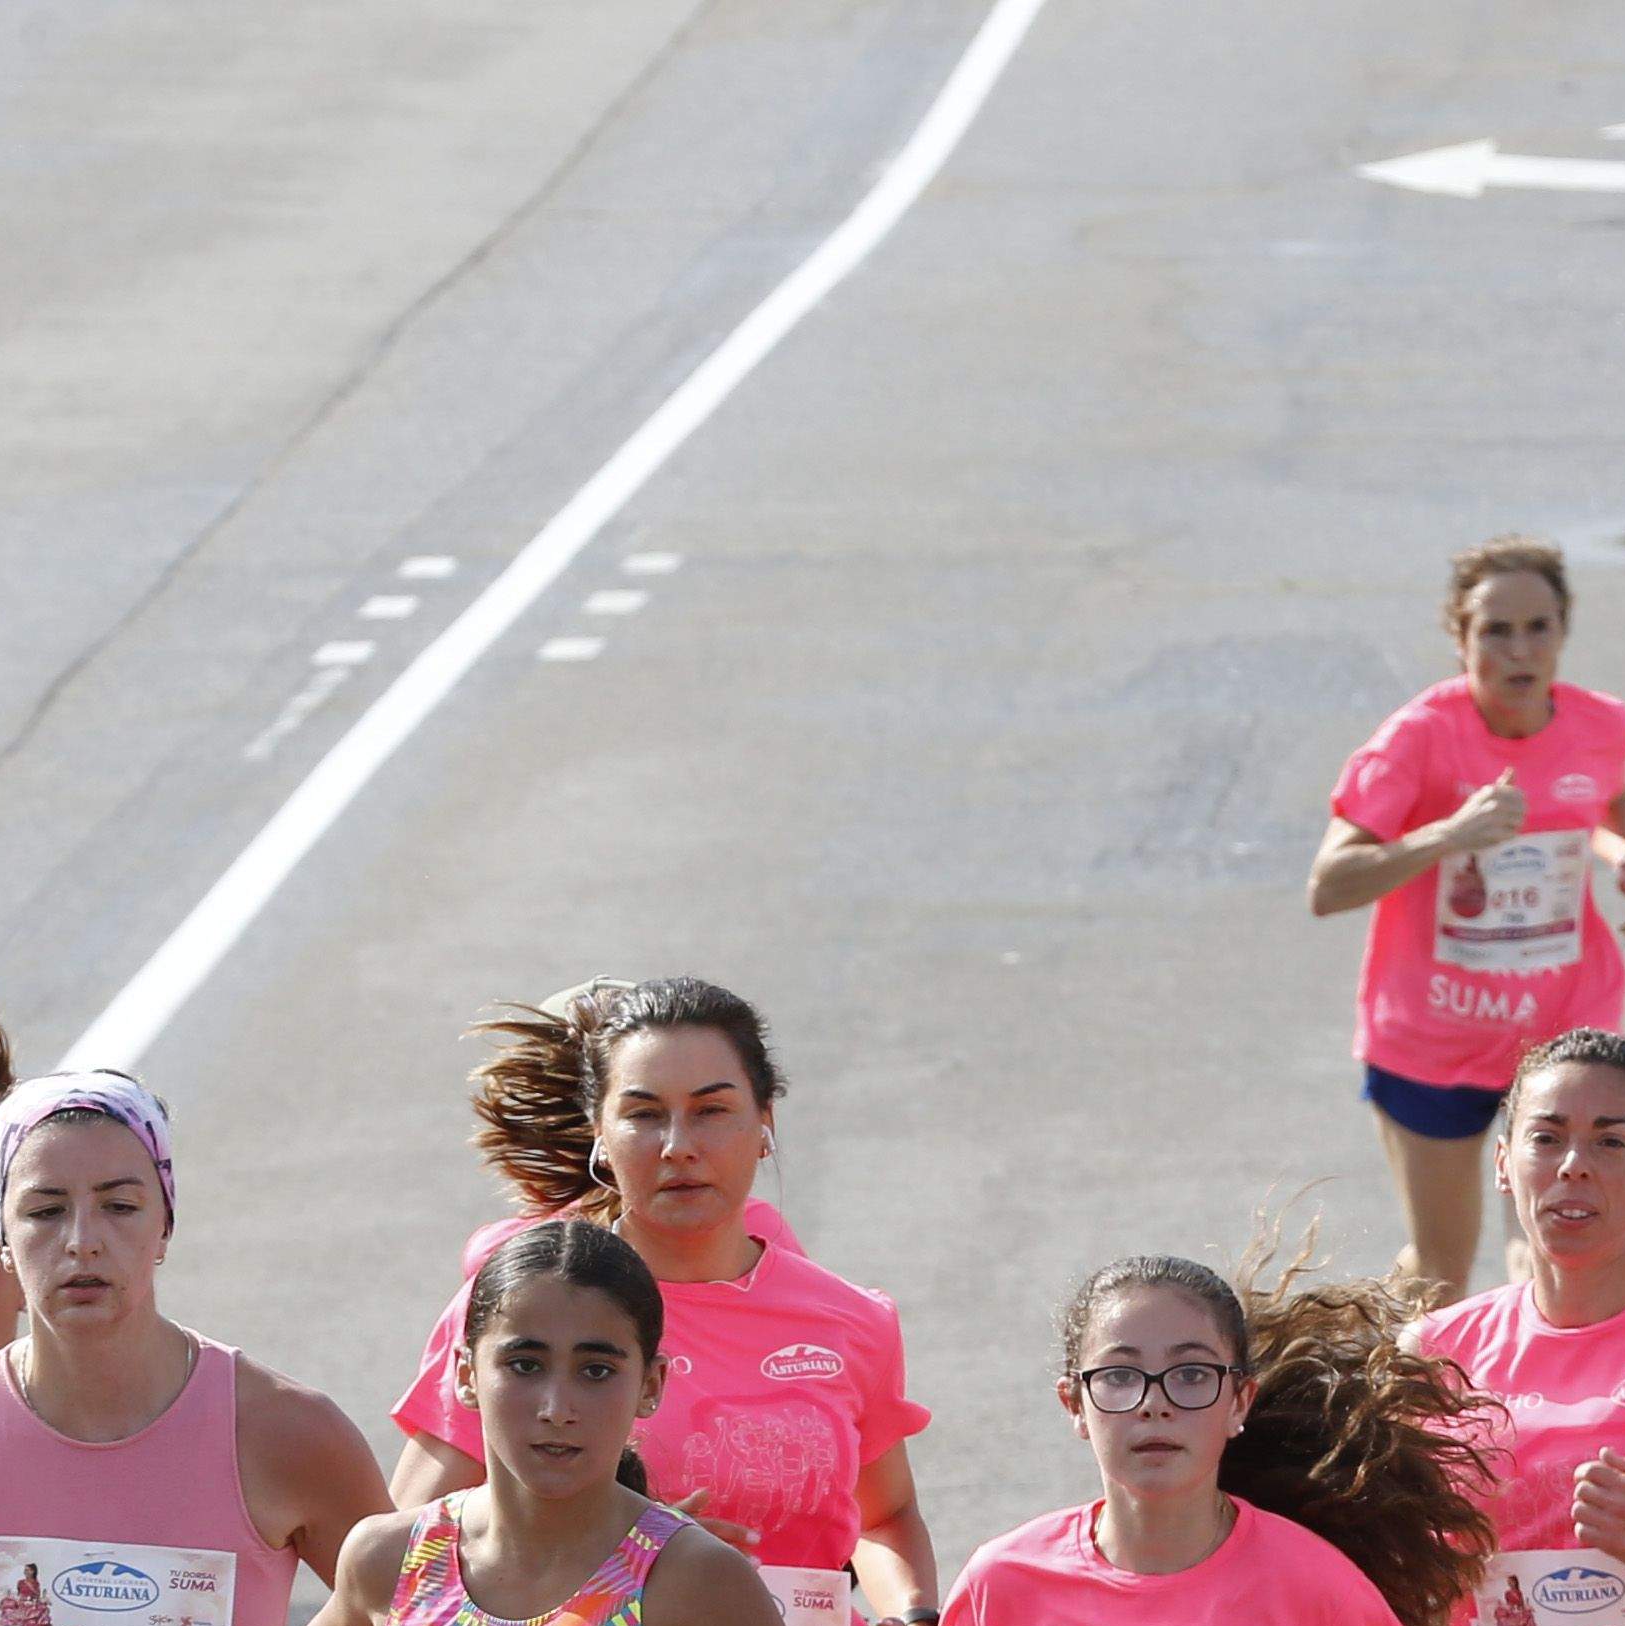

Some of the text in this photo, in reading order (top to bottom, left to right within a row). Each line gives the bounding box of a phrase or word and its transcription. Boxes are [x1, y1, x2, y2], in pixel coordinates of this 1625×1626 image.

[1430, 974, 1536, 1021] SUMA
[769, 1360, 838, 1375] ASTURIANA
[183, 1570, 217, 1580] DORSAL
[60, 1577, 151, 1600] ASTURIANA
[169, 1578, 216, 1592] SUMA
[1541, 1585, 1619, 1603] ASTURIANA
[793, 1597, 834, 1610] SUMA
